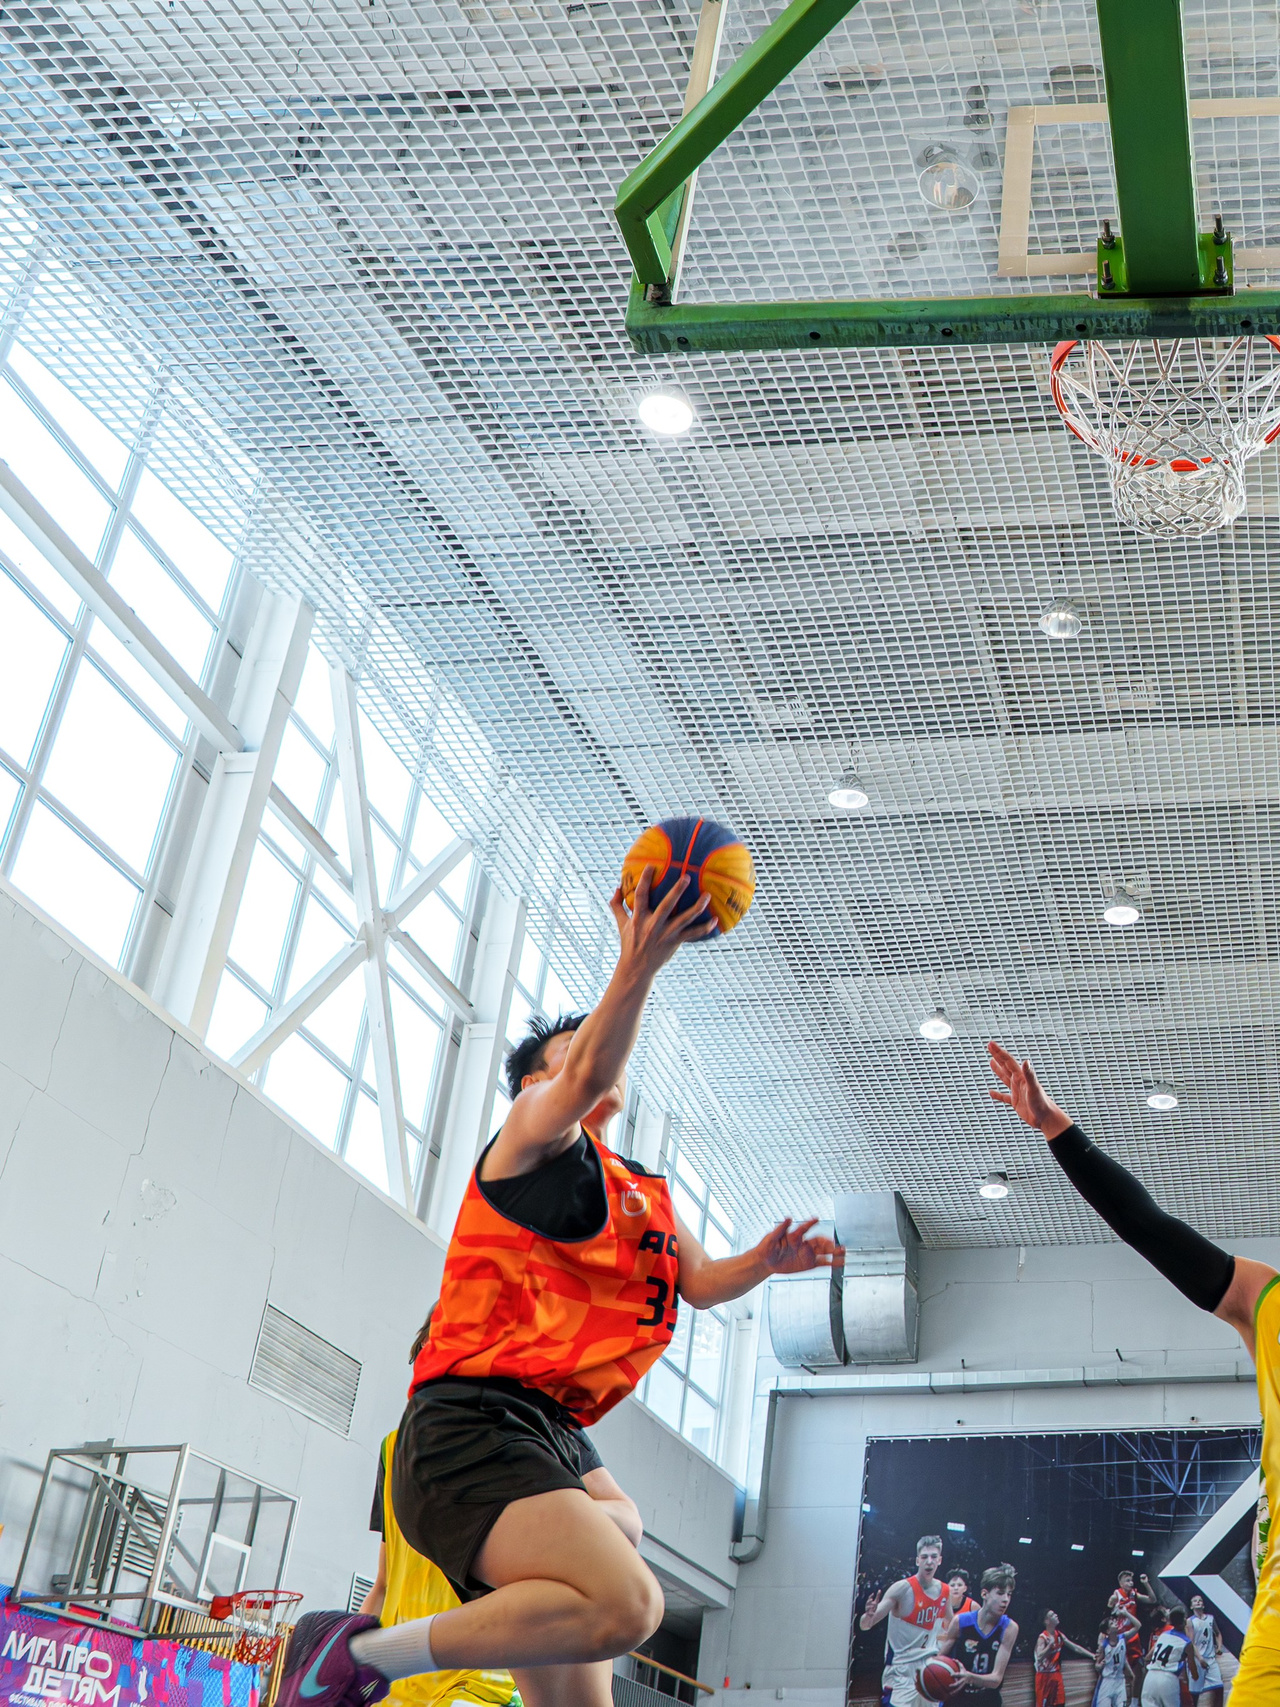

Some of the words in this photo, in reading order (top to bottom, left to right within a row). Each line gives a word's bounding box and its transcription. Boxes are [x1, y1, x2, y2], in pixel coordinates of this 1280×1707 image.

[1, 1630, 57, 1668] ЛИГА
[58, 1643, 113, 1679] ПРО
[1151, 1643, 1174, 1667] 14
[22, 1665, 121, 1707] ДЕТЯМ
